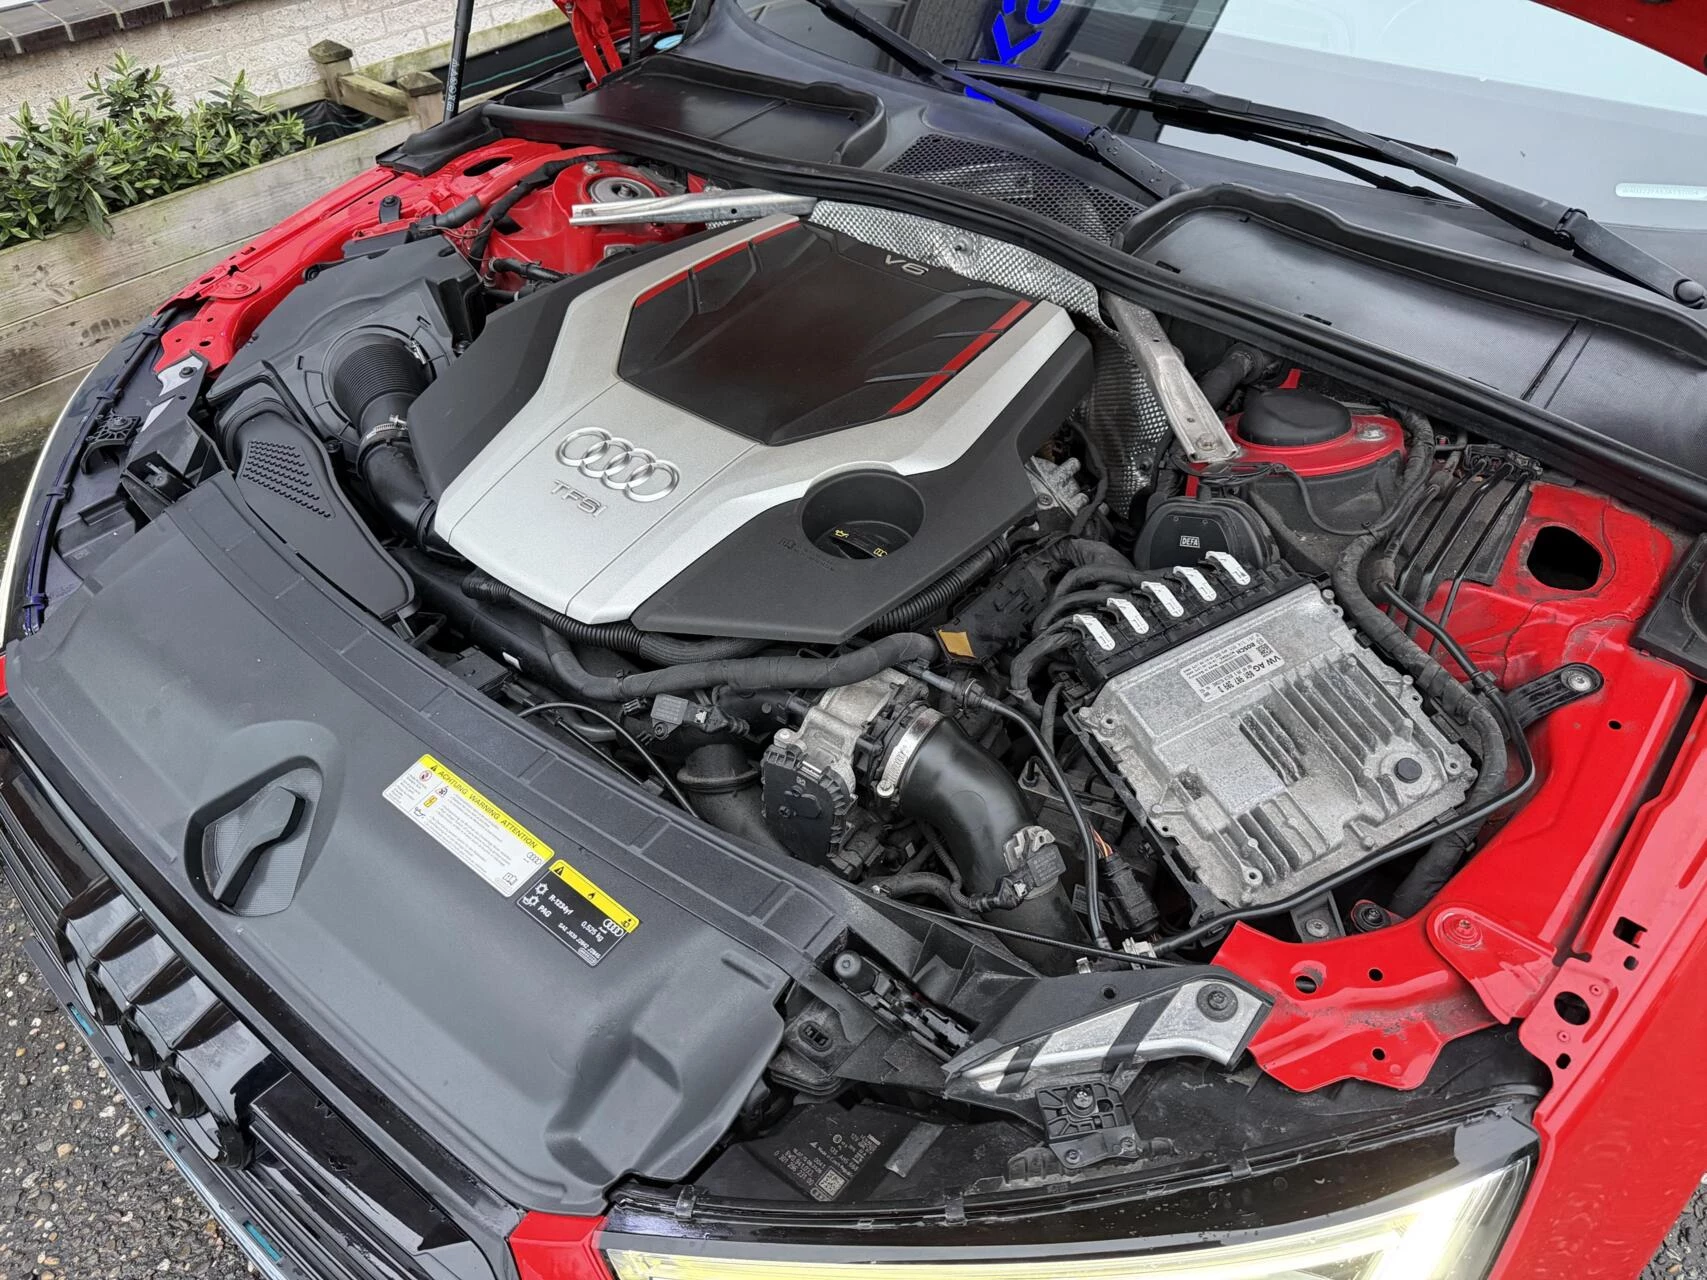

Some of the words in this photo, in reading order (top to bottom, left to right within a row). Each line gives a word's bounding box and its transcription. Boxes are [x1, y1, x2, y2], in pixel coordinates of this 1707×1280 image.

[885, 254, 929, 276] V6
[550, 479, 608, 518] TFSI
[1181, 536, 1199, 547] DEFA
[1235, 641, 1256, 654] BOSCH
[1252, 662, 1266, 672] AG
[1265, 655, 1281, 666] VW
[437, 770, 468, 795] ACHTUNG
[468, 793, 501, 820] WARNING
[499, 818, 538, 849] ATTENTION
[537, 905, 552, 918] PAG
[548, 894, 574, 916] R-1234yf
[581, 921, 598, 936] 0,525
[595, 932, 605, 942] kg
